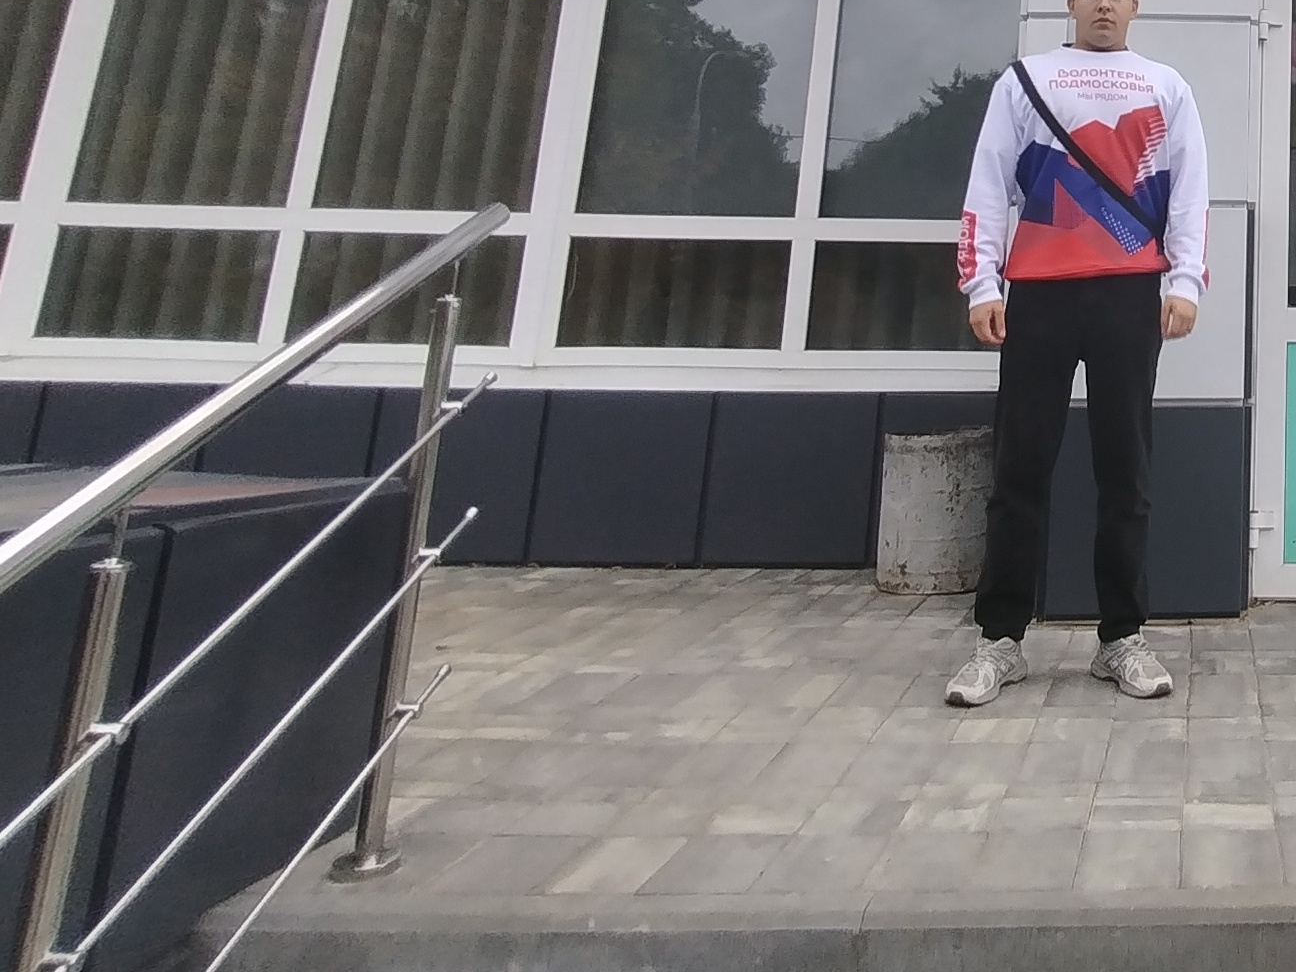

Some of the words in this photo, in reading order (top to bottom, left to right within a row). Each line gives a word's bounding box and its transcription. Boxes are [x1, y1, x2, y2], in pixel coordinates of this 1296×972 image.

[1057, 68, 1146, 82] ВОЛОНТЕРЫ
[1049, 79, 1154, 94] ПОДМОСКОВЬЯ
[1077, 92, 1093, 101] МЫ
[1095, 93, 1128, 101] РЯДОМ
